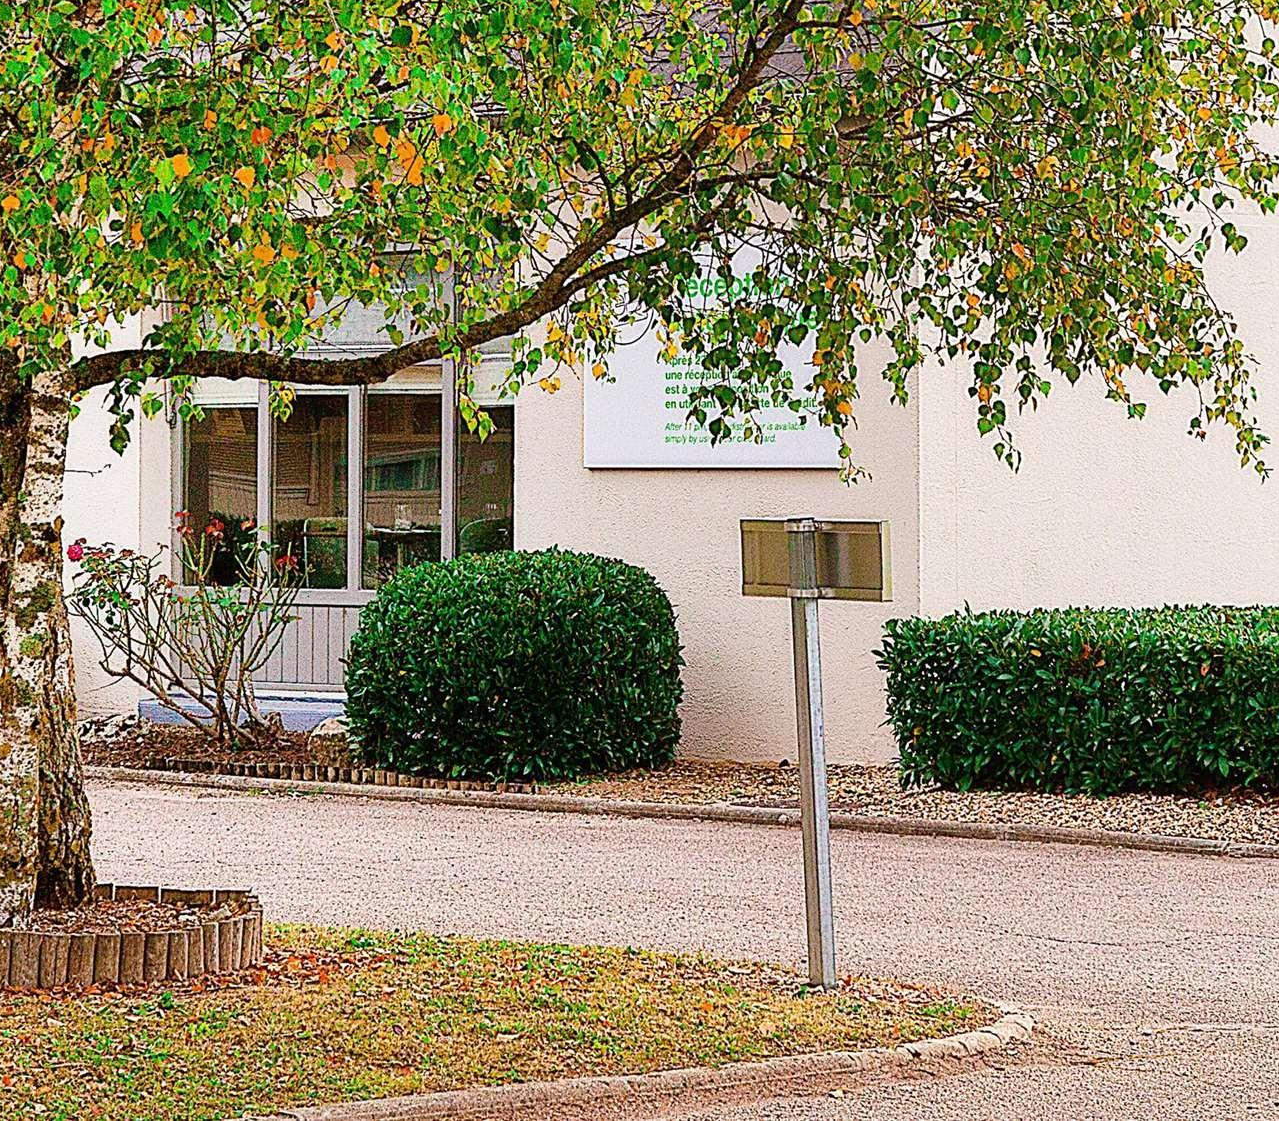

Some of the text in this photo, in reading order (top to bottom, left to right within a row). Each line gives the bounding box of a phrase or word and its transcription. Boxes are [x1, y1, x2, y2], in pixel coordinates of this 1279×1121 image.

[665, 371, 683, 380] une
[684, 369, 724, 381] réceptio
[665, 386, 680, 395] est
[665, 401, 677, 409] en
